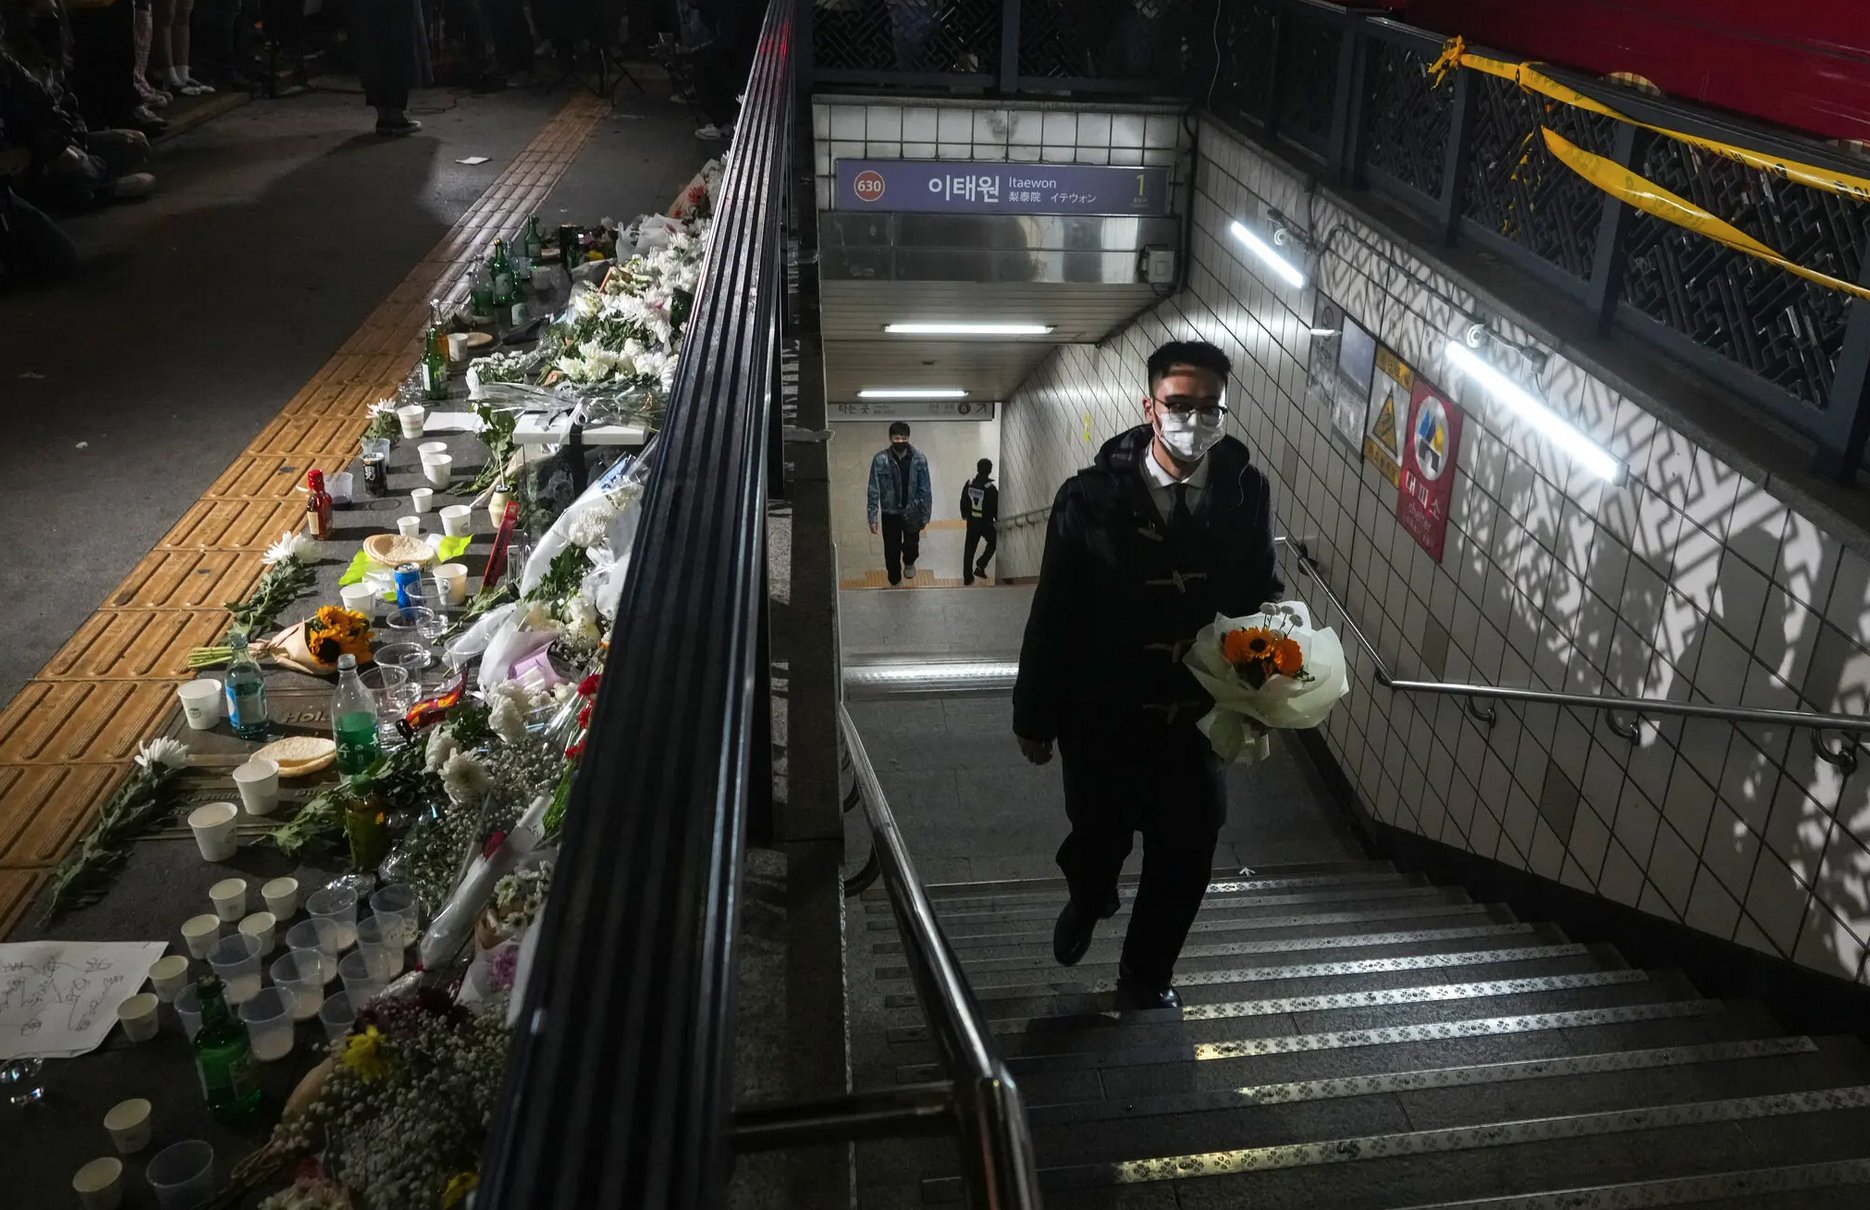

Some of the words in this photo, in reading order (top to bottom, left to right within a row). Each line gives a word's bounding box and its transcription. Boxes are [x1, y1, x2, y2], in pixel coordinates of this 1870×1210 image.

[857, 180, 882, 192] 630
[928, 174, 999, 203] 이태원
[1008, 176, 1057, 189] Itaewon
[1135, 174, 1145, 196] 1
[1008, 191, 1042, 203] 梨泰院
[1050, 193, 1097, 204] イテウォン
